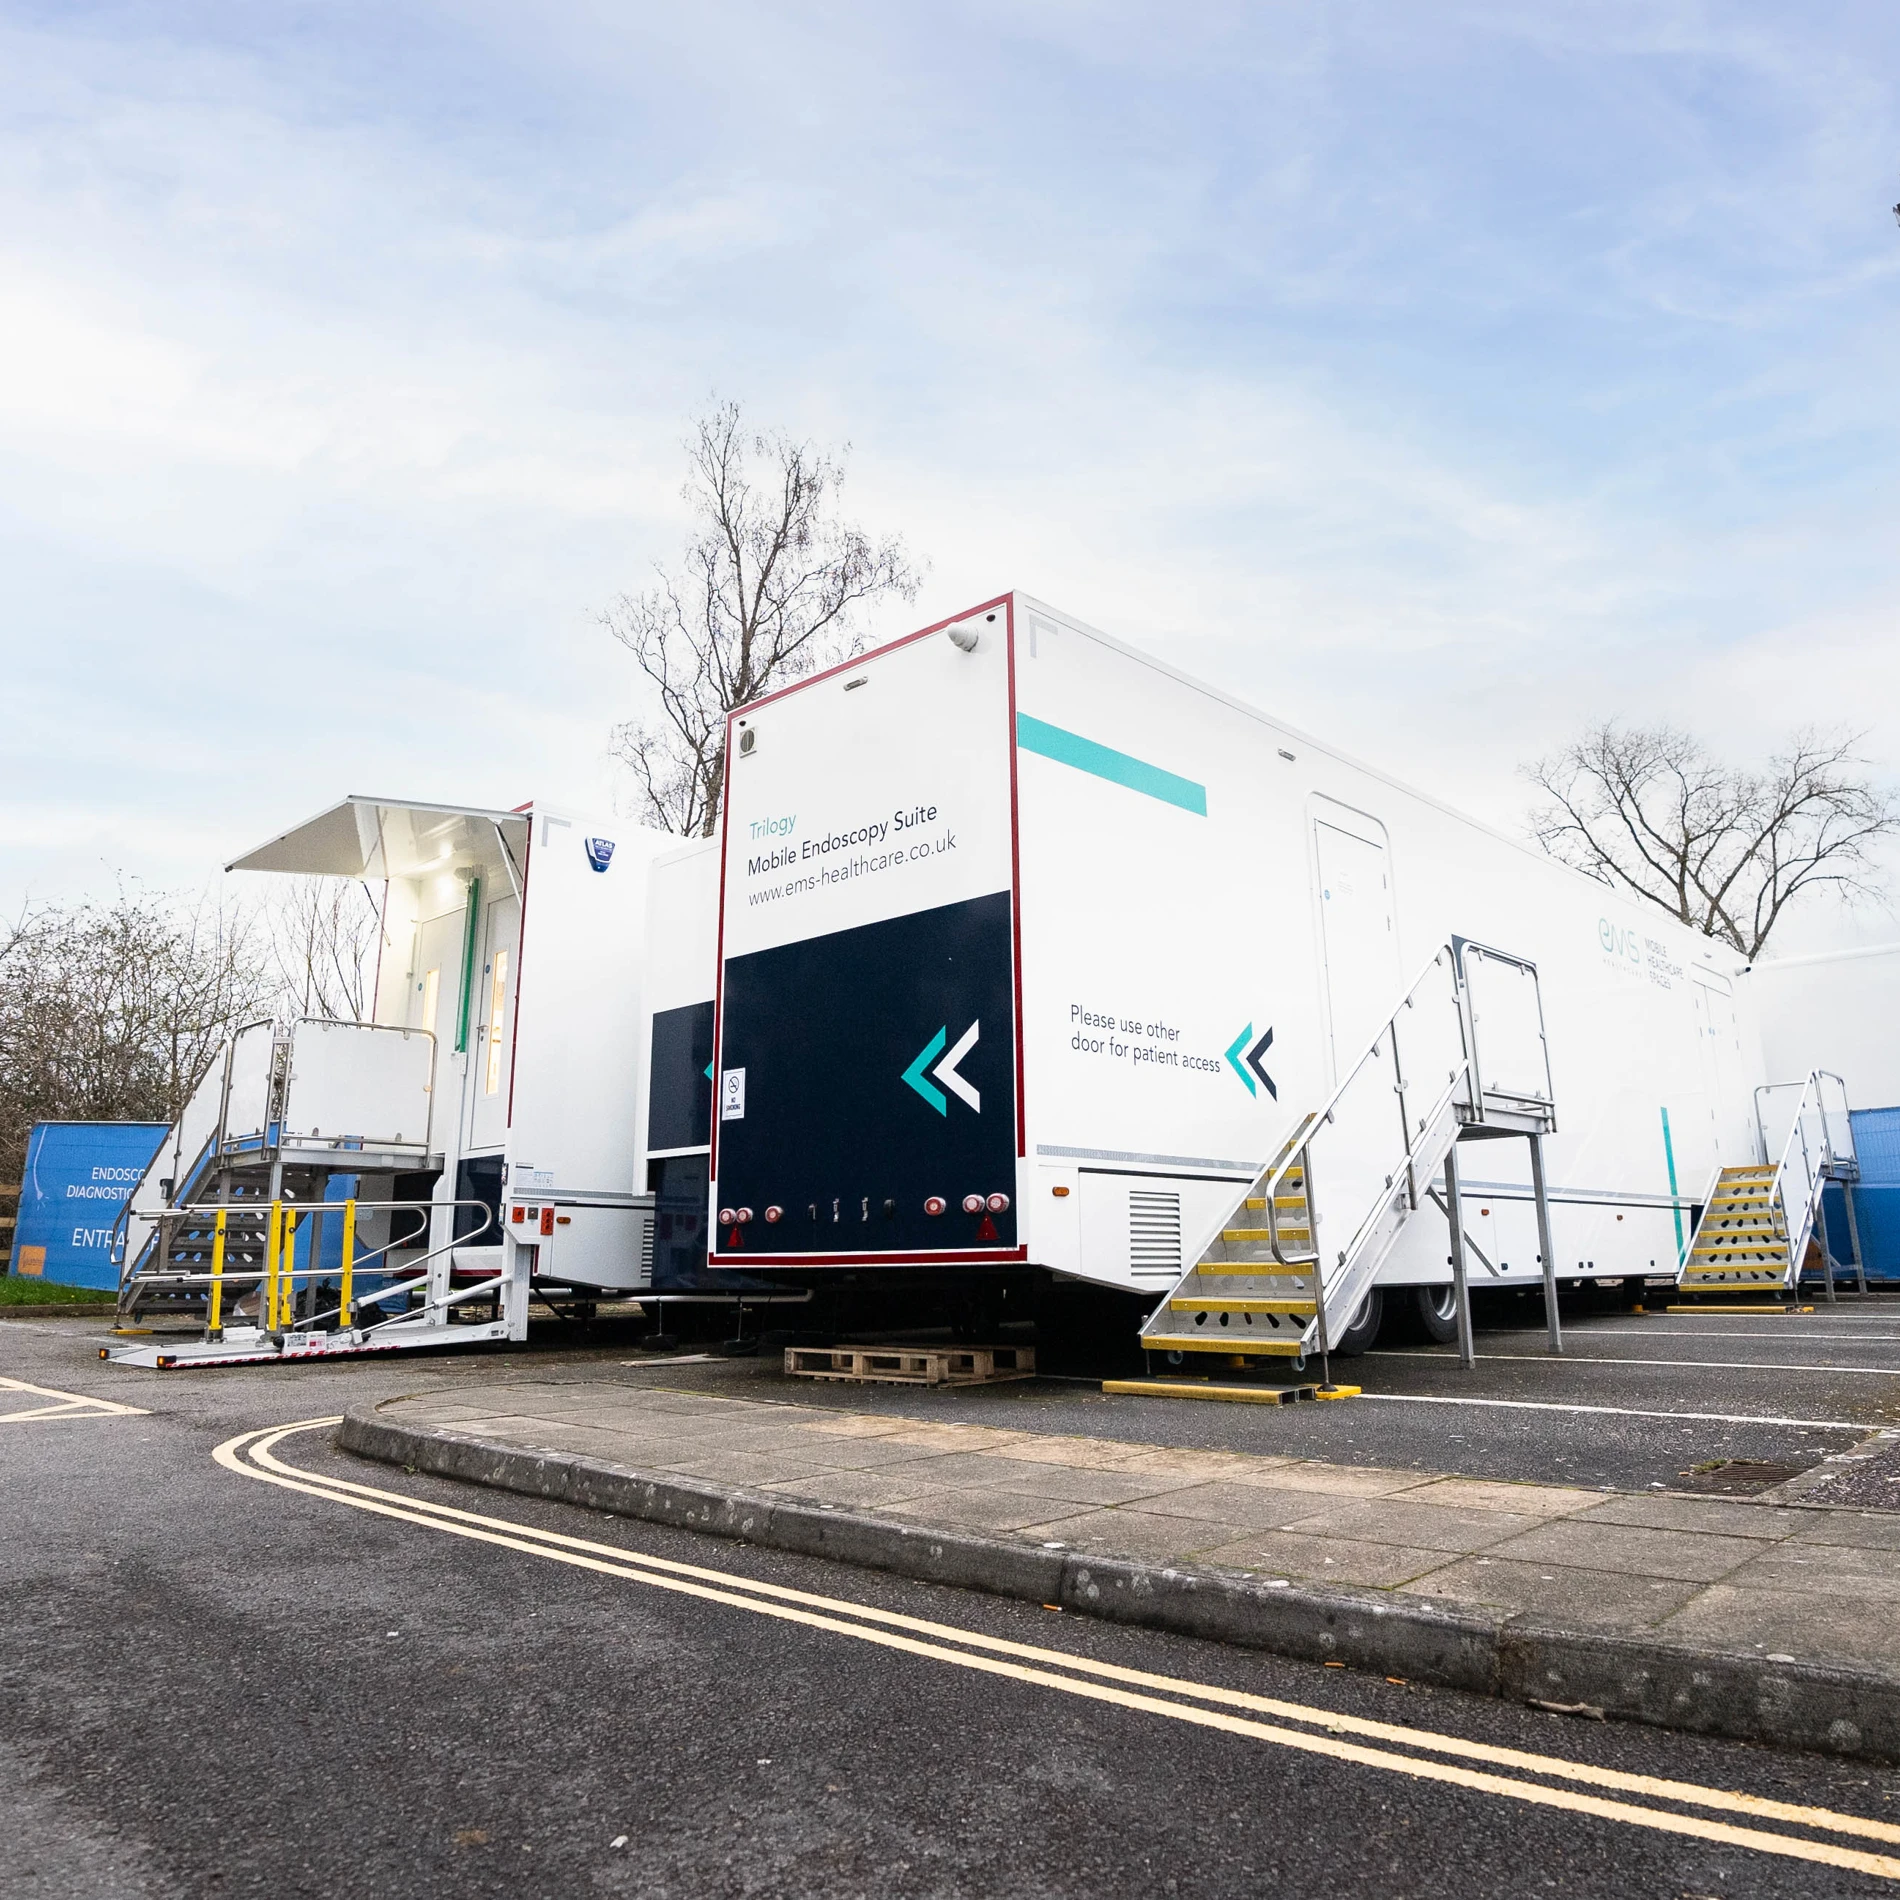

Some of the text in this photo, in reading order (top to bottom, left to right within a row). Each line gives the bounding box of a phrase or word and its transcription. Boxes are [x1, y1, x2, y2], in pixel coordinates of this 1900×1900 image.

[748, 804, 937, 876] Mobile Endoscopy Suite
[749, 813, 797, 840] Trilogy
[595, 840, 612, 848] ATLAS
[748, 829, 957, 907] www.ems-healthcare.co.uk
[1644, 937, 1668, 958] MOBILE
[1647, 955, 1684, 980] HEALTHCARE
[1071, 1004, 1181, 1042] Please use other
[1071, 1031, 1221, 1073] door for patient access
